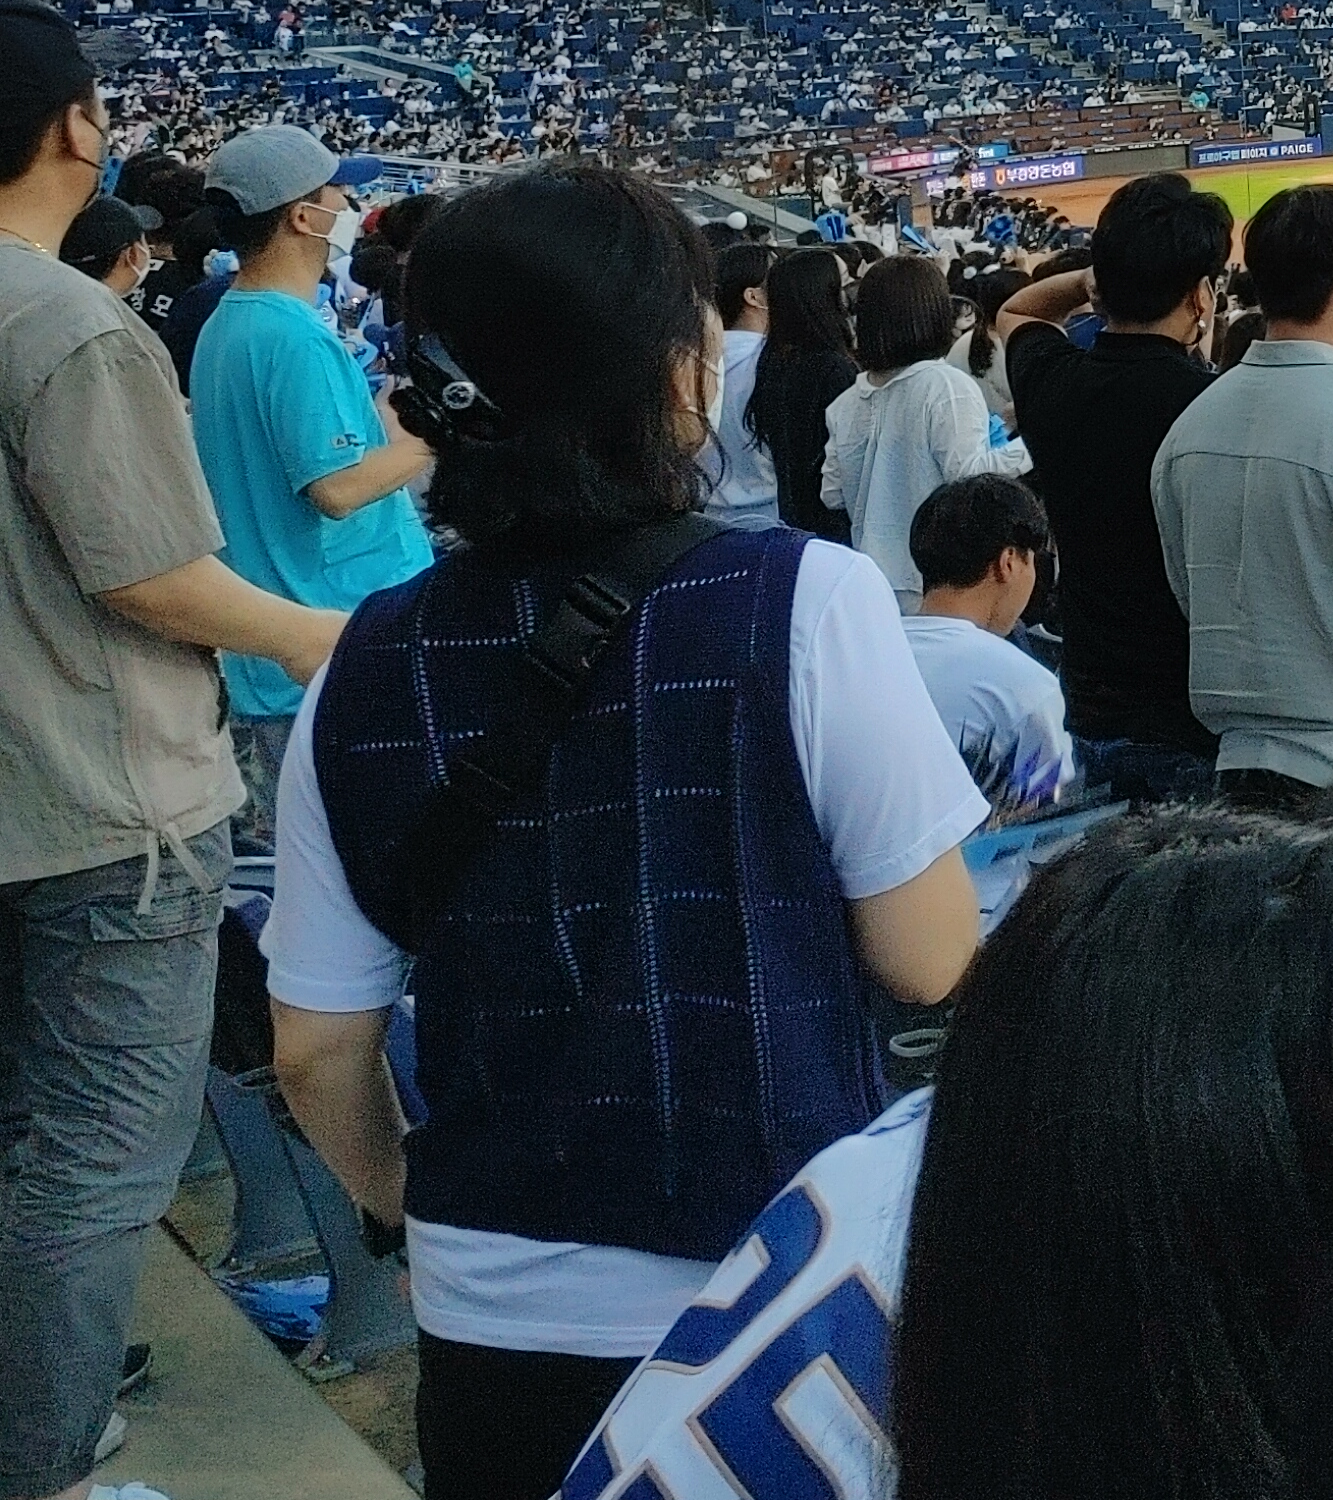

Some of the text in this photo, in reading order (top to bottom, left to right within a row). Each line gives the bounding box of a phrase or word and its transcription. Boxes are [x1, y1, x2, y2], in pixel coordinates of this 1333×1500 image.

[1241, 147, 1268, 159] 페이지
[1281, 144, 1314, 155] PAIGE
[1007, 161, 1075, 182] 부경양돈농협
